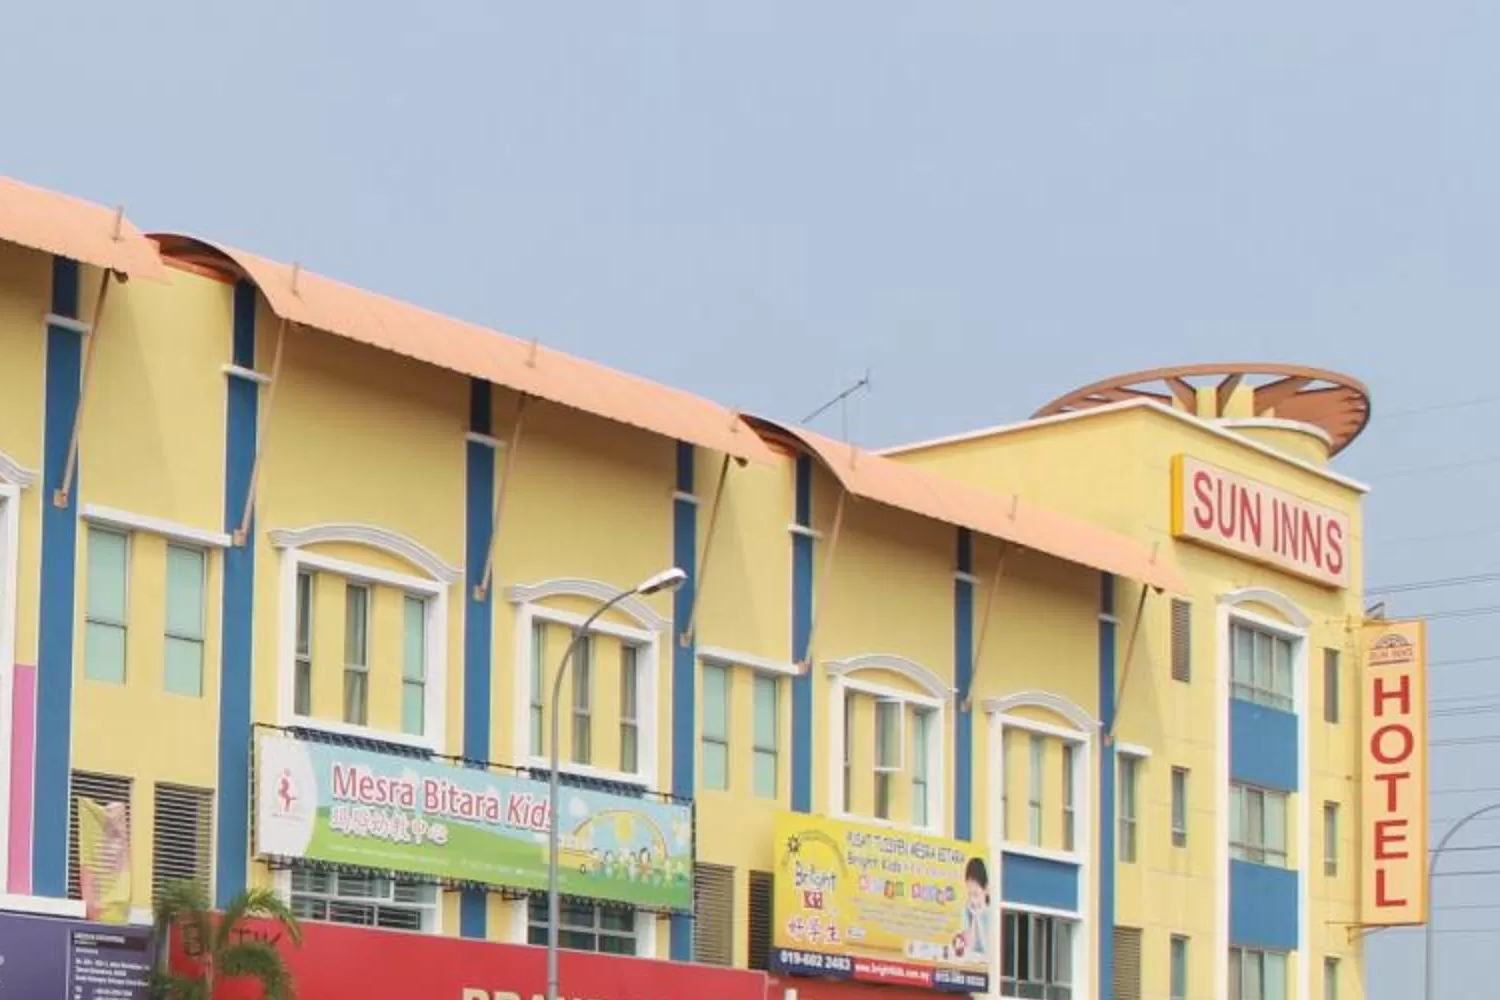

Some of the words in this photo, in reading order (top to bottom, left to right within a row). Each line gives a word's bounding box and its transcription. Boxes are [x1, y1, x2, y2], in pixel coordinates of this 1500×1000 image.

[1193, 470, 1261, 548] SUN
[1272, 496, 1344, 576] INNS
[332, 764, 414, 807] Mesra
[424, 779, 499, 821] Bitara
[1369, 675, 1414, 908] HOTEL
